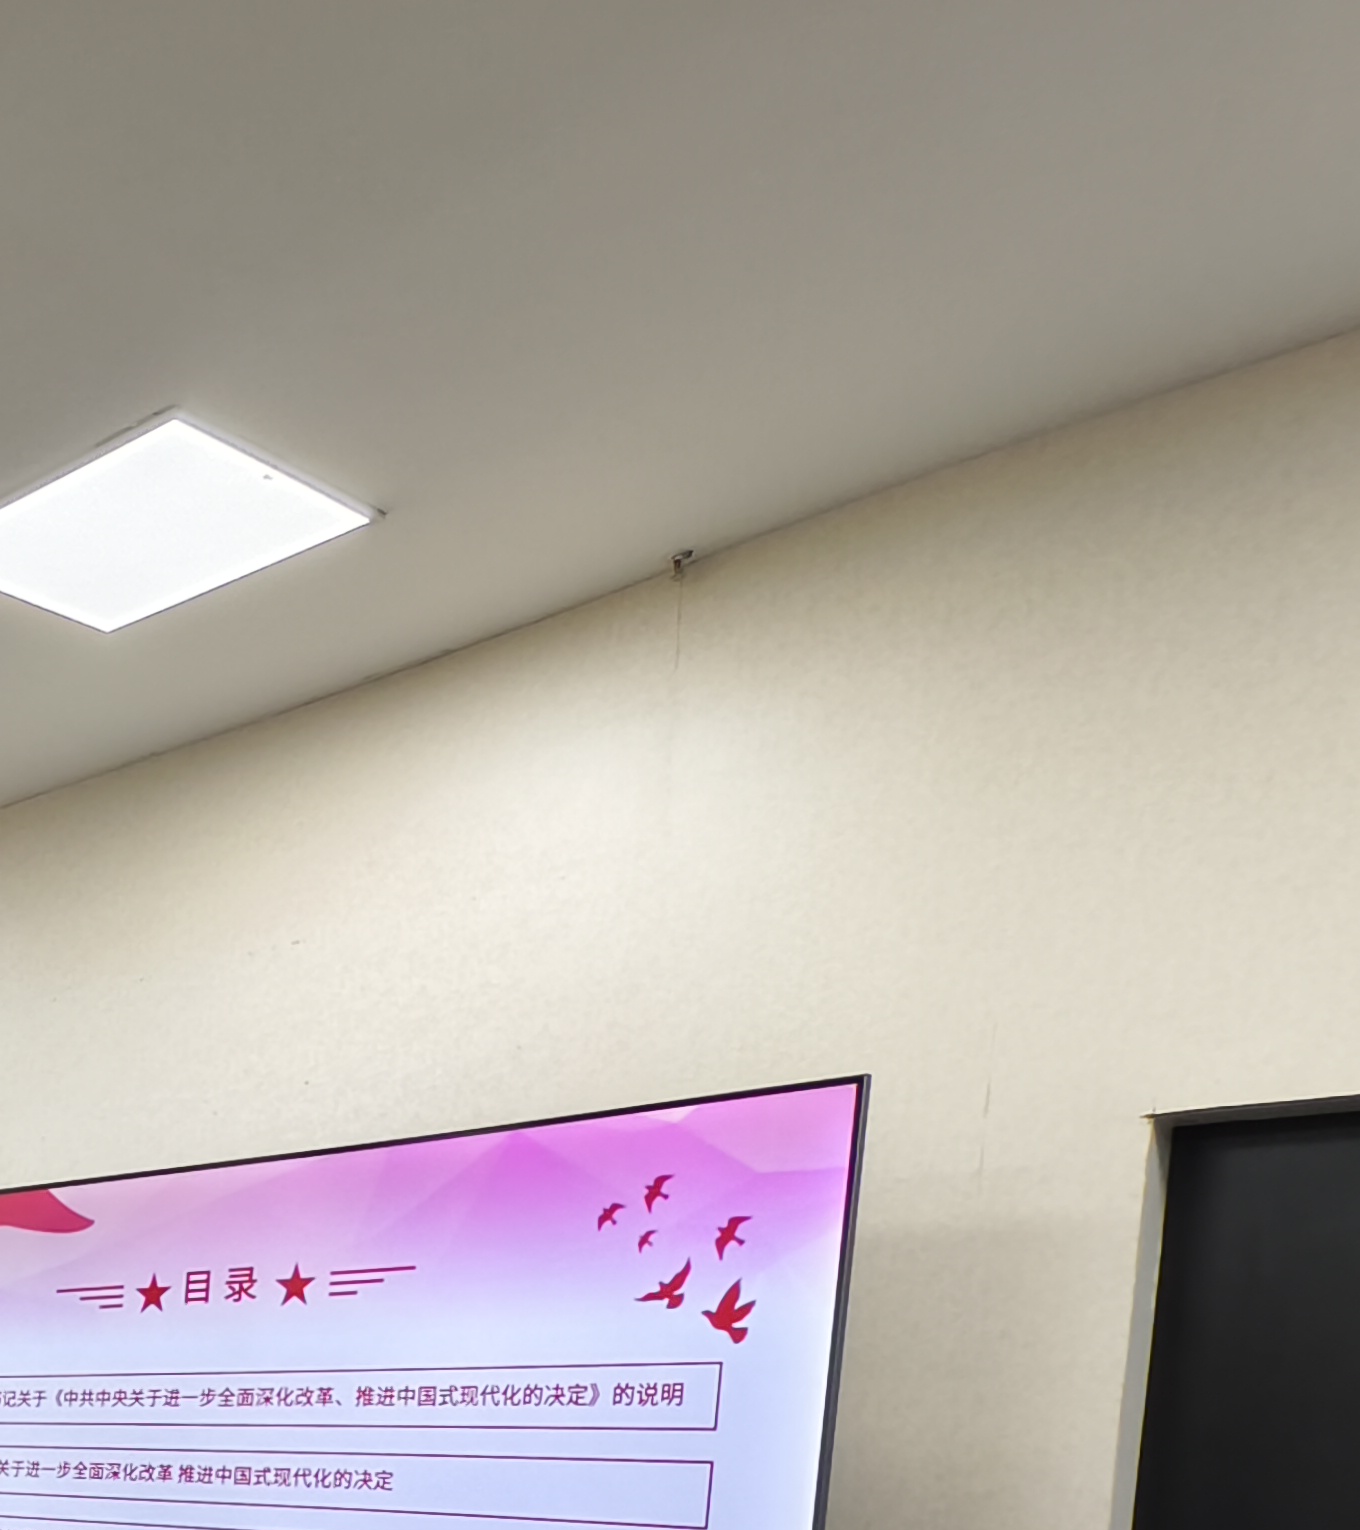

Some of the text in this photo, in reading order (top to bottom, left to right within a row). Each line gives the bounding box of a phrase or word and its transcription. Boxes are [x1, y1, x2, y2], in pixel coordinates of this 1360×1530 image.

[184, 1266, 257, 1304] 目录
[178, 1465, 394, 1491] 推进中国式现代化的决定
